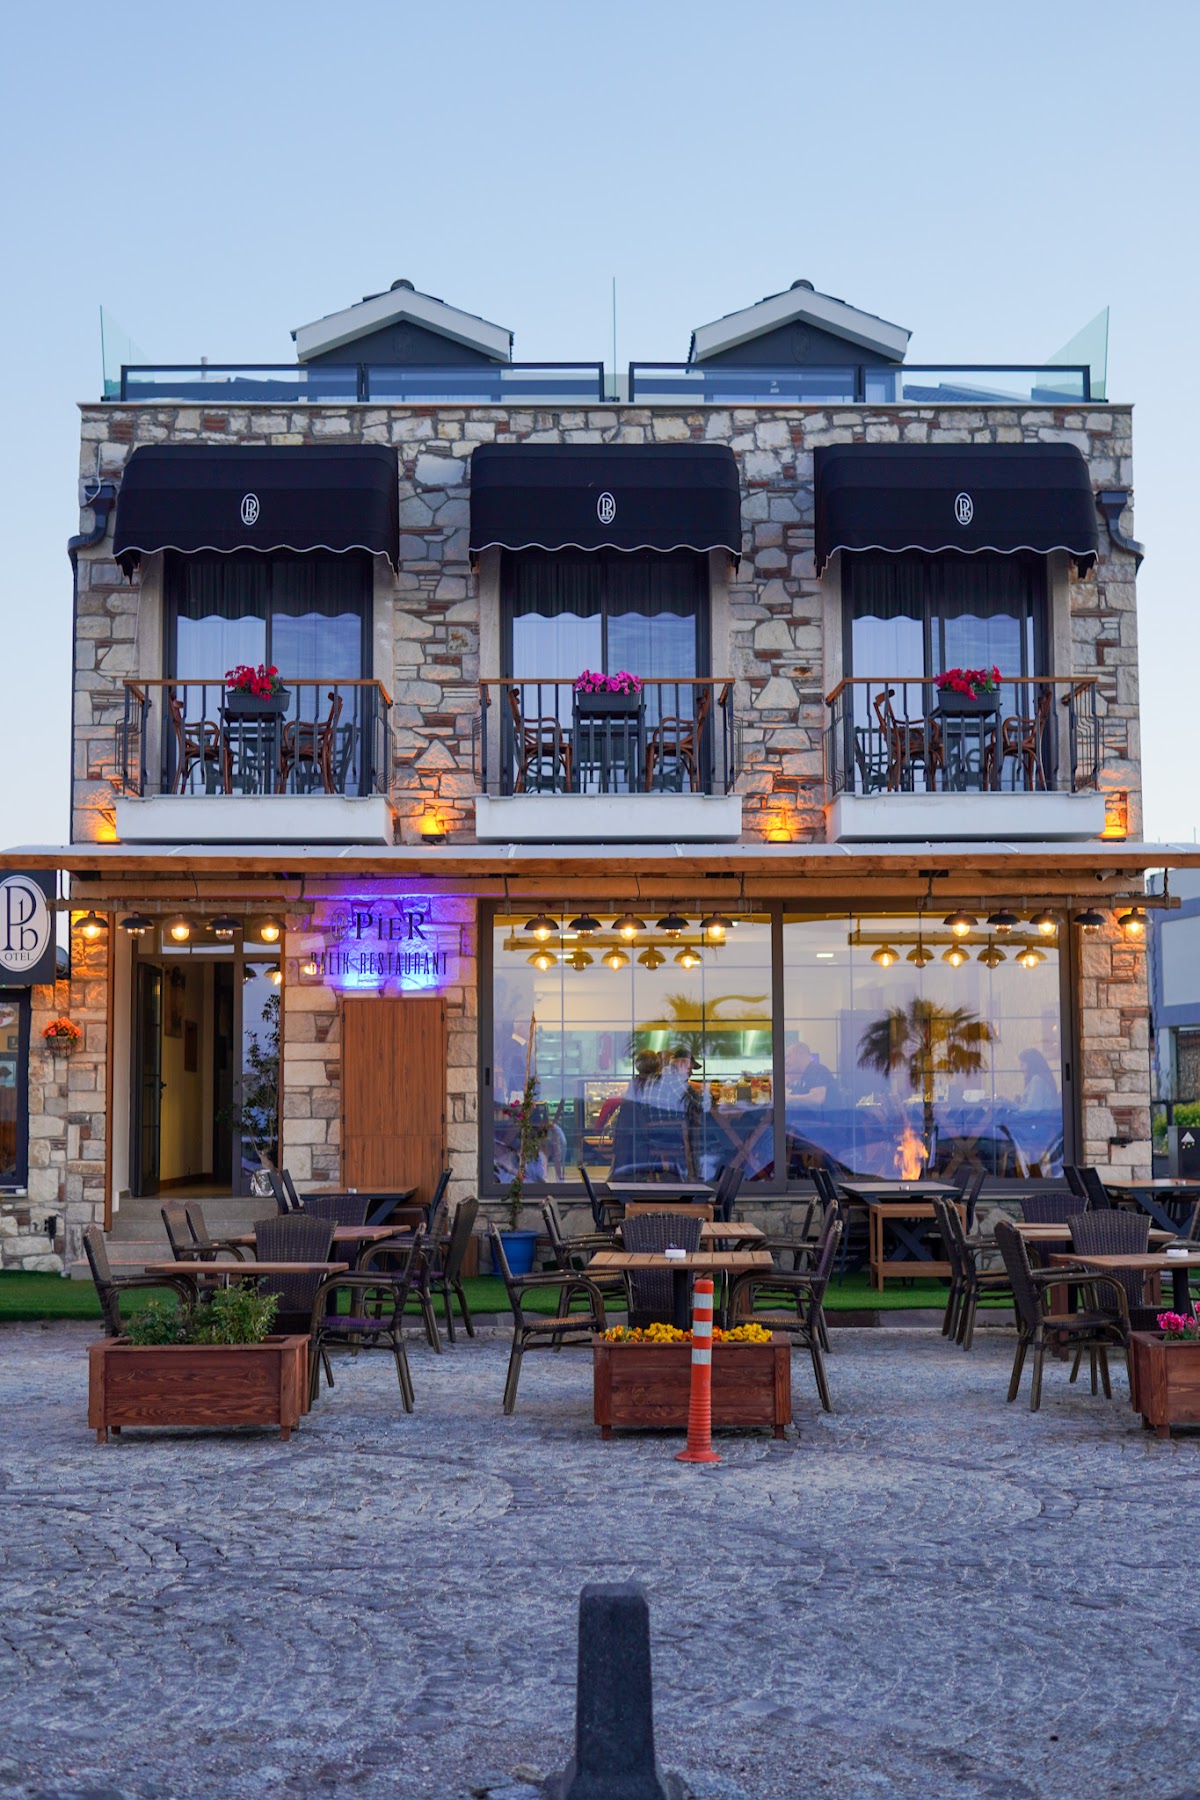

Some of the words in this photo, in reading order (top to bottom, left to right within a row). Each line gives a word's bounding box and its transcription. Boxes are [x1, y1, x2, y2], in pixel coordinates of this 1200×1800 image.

[5, 952, 34, 962] OTEL
[311, 951, 350, 976] BALIK
[360, 952, 448, 976] RESTAURANT
